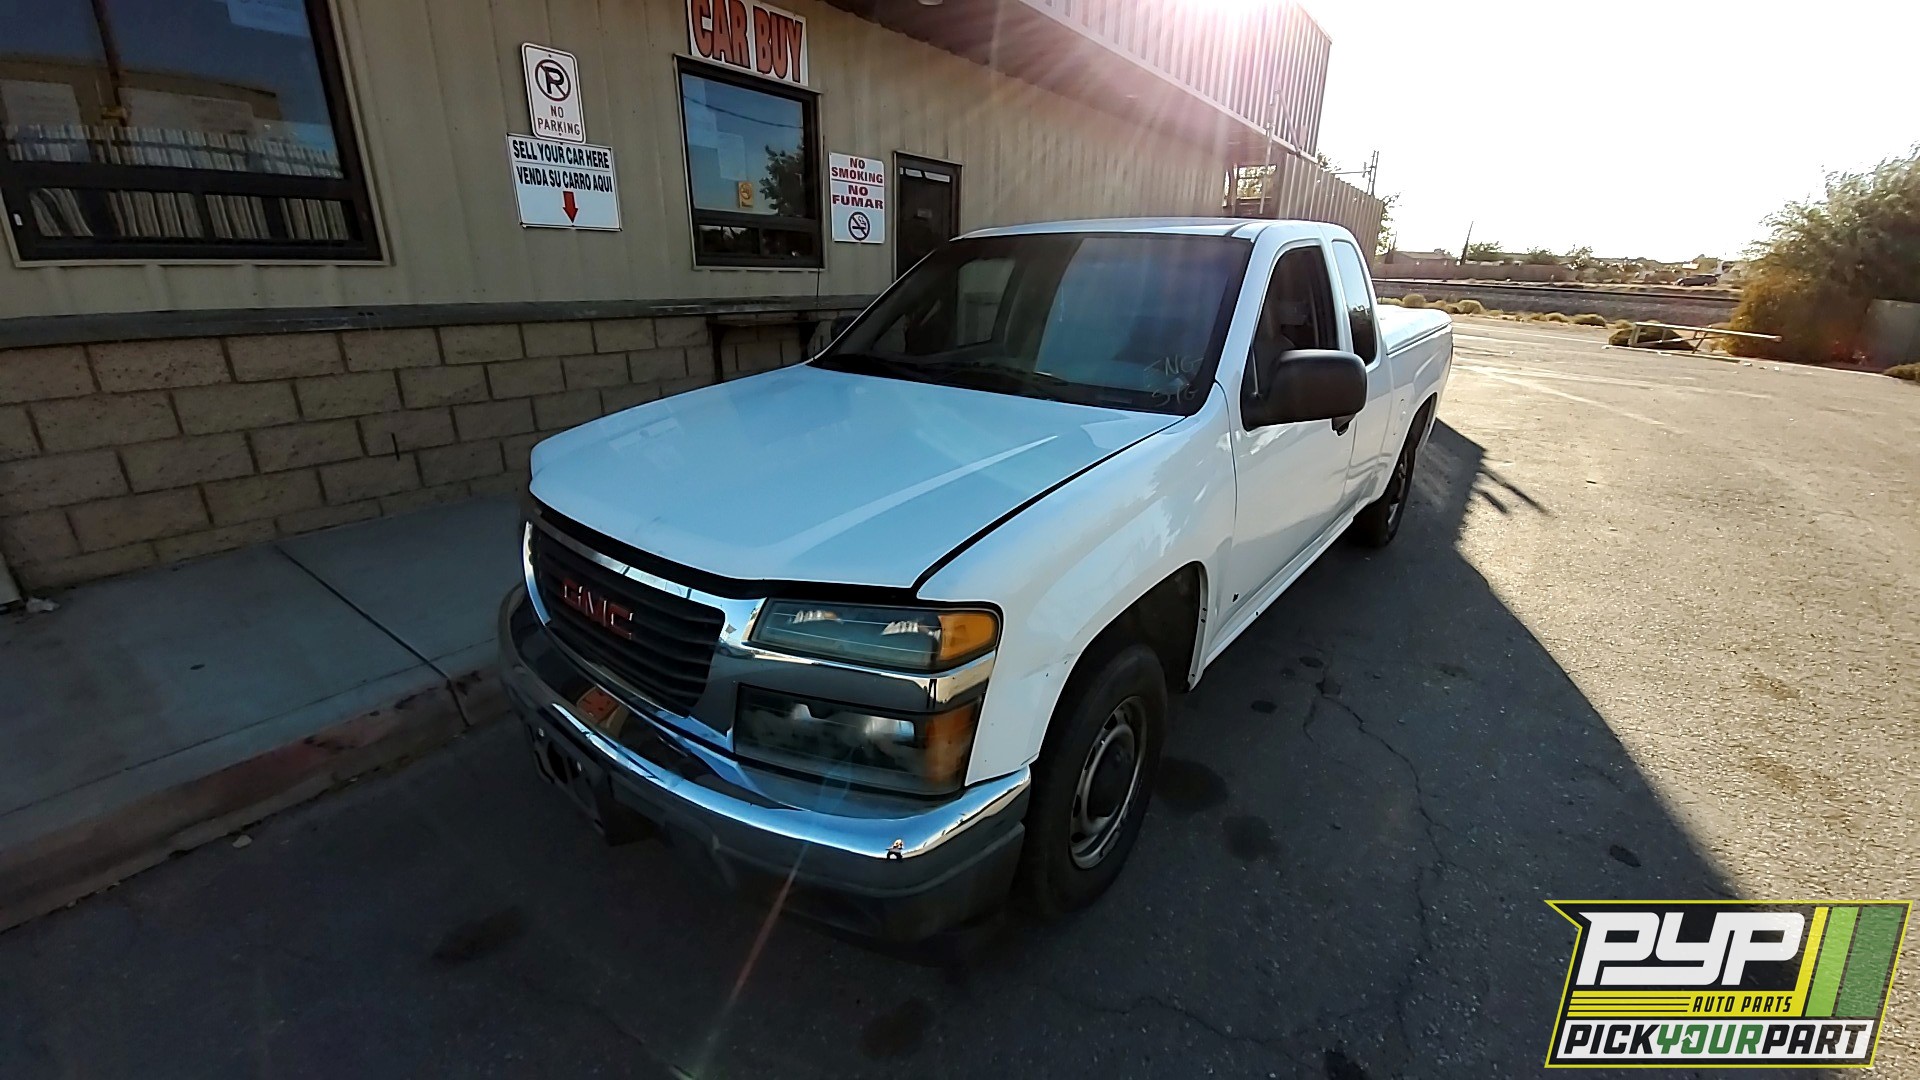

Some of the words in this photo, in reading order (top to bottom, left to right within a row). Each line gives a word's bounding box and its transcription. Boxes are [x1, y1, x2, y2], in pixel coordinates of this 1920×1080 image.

[690, 0, 751, 69] CAR
[752, 5, 803, 83] BUY
[550, 105, 564, 119] NO
[537, 117, 581, 136] PARKING
[513, 139, 538, 161] SELL
[537, 142, 566, 164] YOUR
[565, 146, 586, 166] CAR
[585, 149, 610, 169] HERE
[850, 157, 866, 170] NO
[516, 165, 549, 187] VENDA
[549, 169, 562, 188] SU
[562, 170, 592, 191] CARRO
[593, 174, 613, 193] AQUI
[831, 166, 884, 184] SMOKING
[848, 184, 869, 196] NO
[832, 194, 884, 210] FUMAR
[562, 578, 634, 640] GMC
